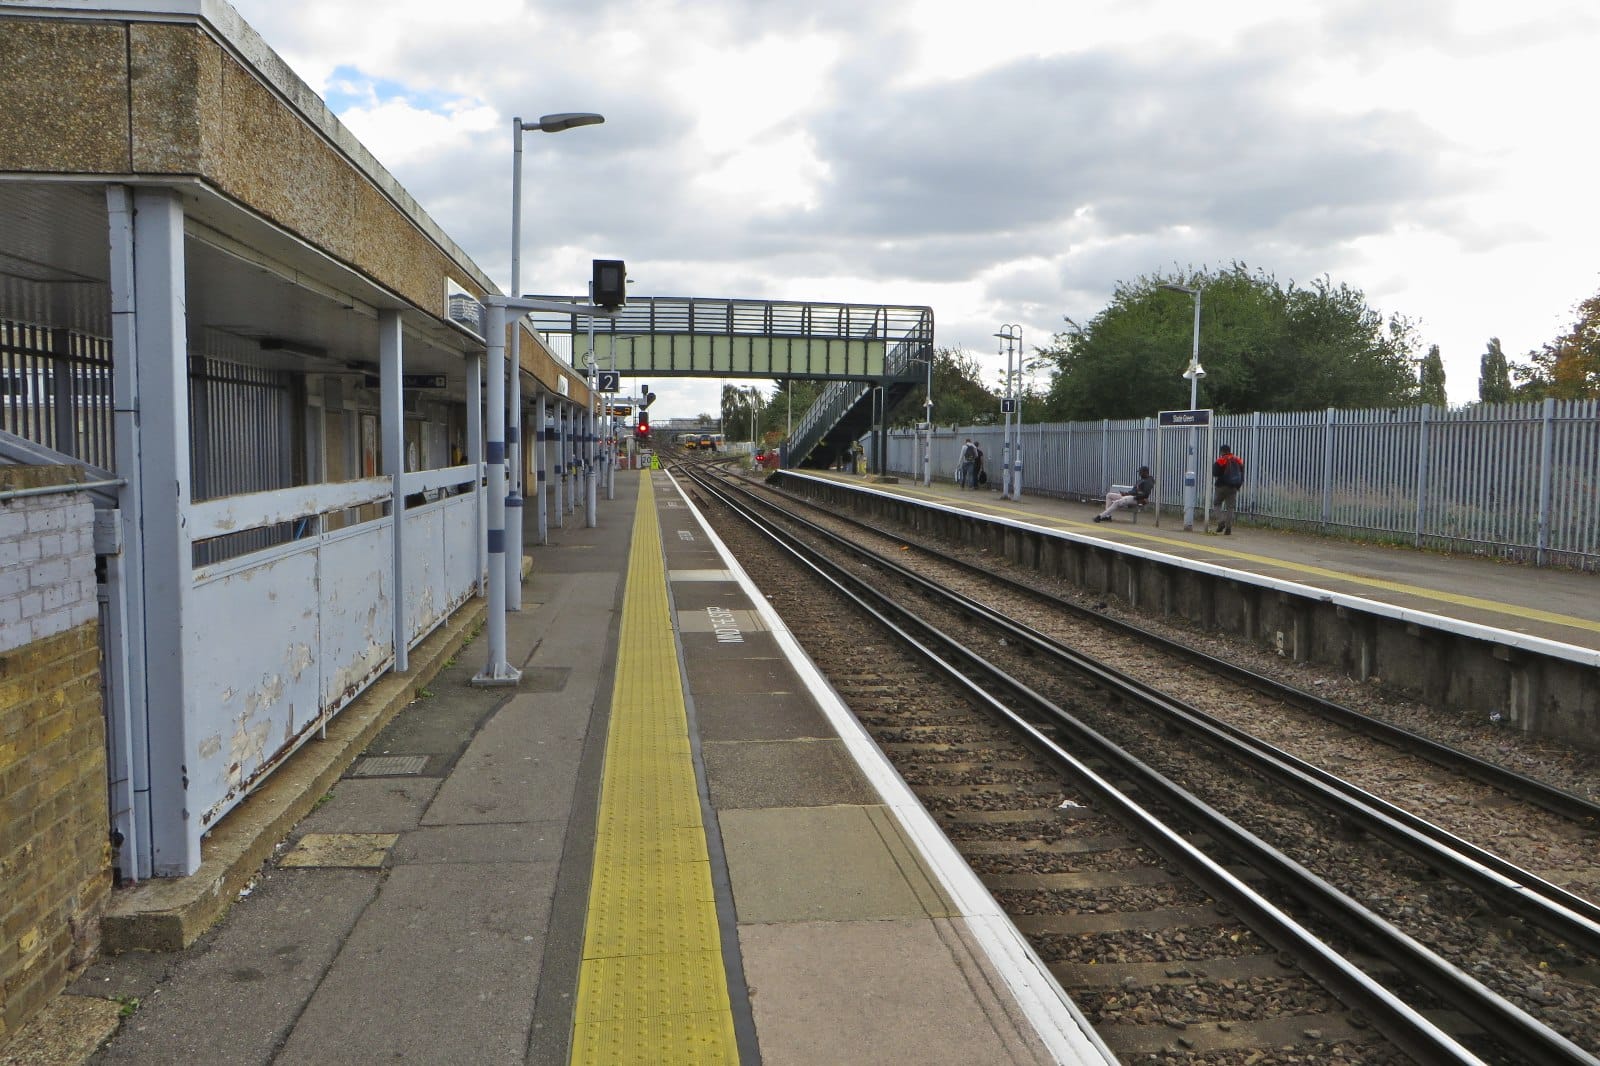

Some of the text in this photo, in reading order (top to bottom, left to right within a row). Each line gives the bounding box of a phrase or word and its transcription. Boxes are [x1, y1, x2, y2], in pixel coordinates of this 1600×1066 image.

[604, 375, 614, 390] 2
[642, 456, 651, 464] 20
[715, 628, 745, 643] MIND
